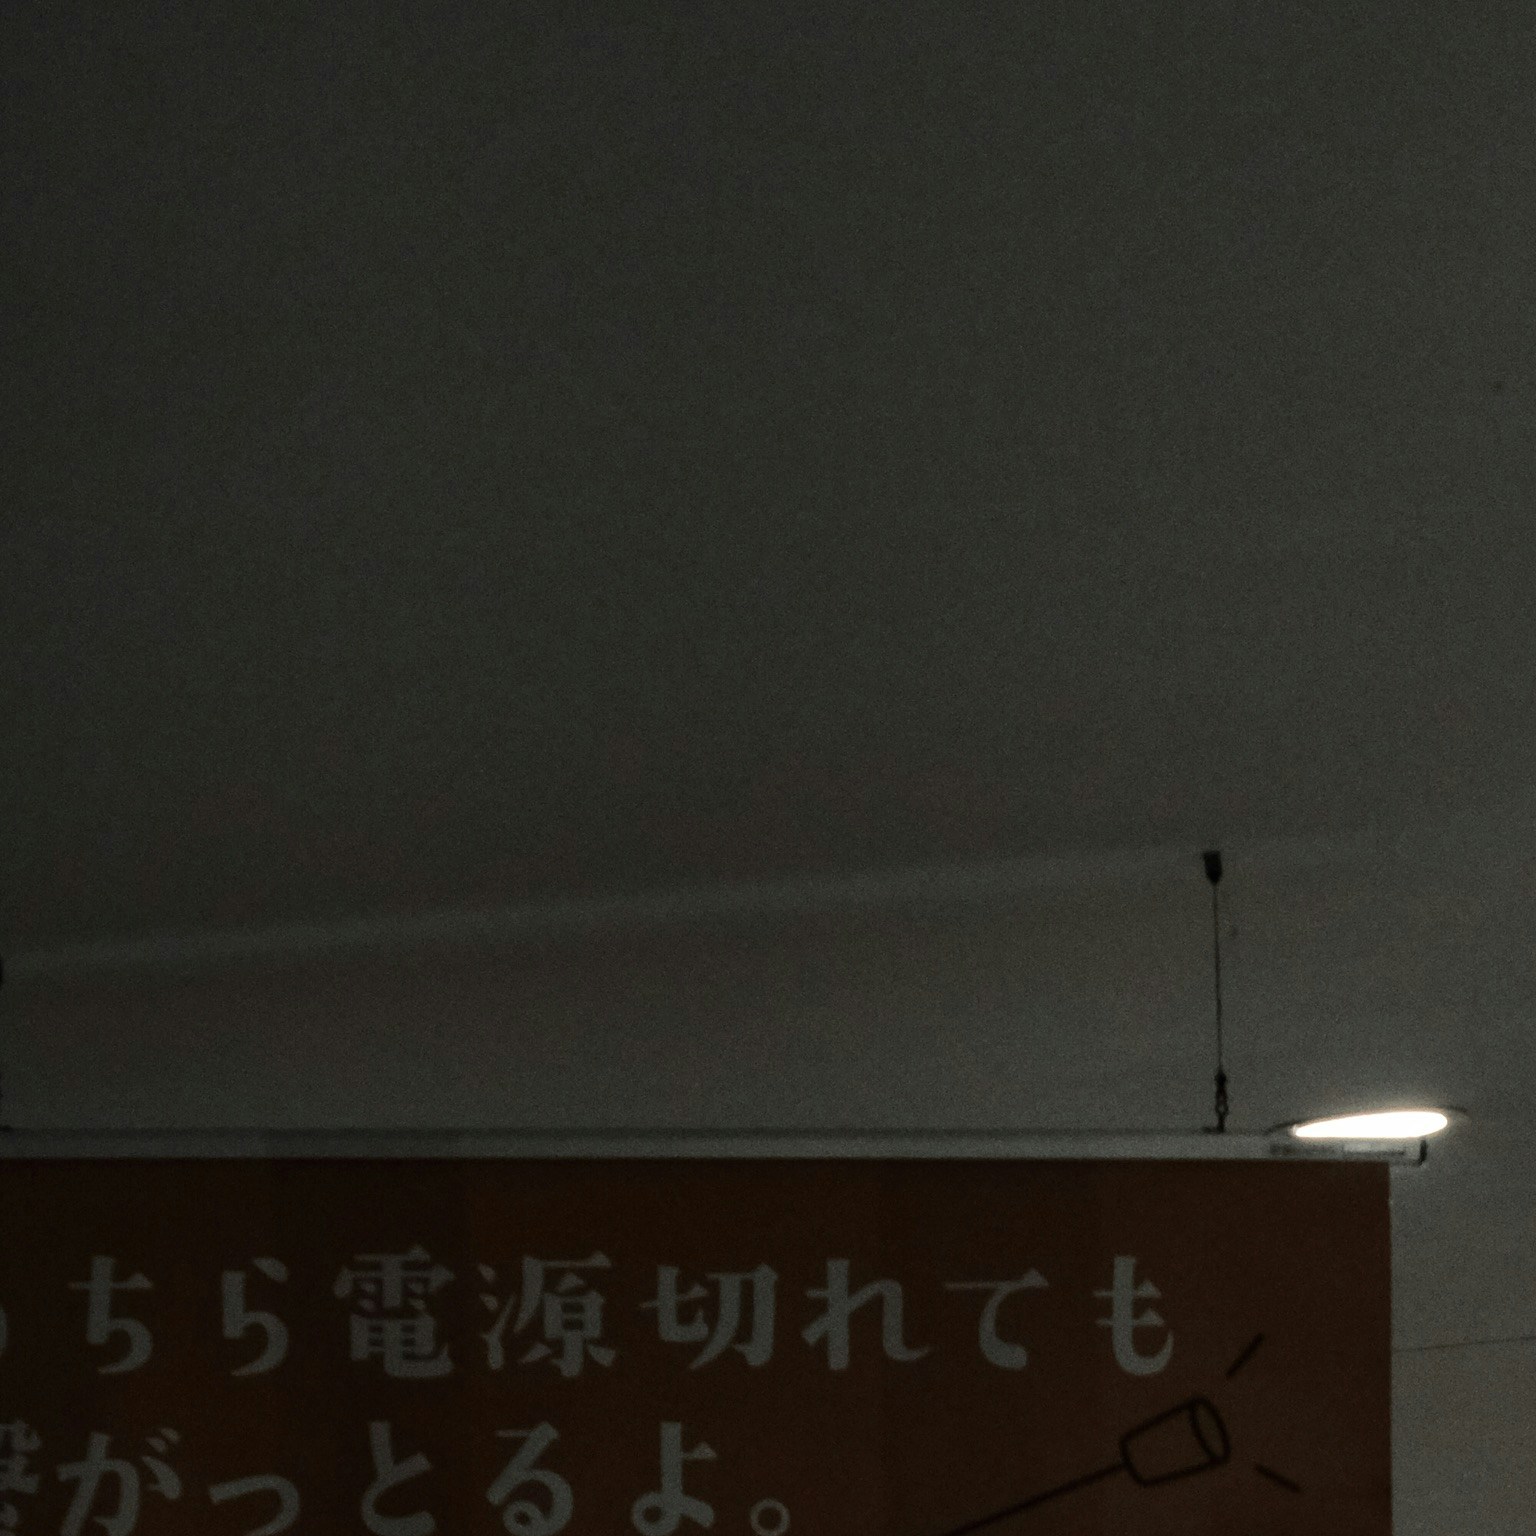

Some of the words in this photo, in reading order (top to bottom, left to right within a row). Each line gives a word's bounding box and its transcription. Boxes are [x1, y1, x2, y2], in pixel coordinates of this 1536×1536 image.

[0, 1245, 1173, 1378] ちら電源切れても
